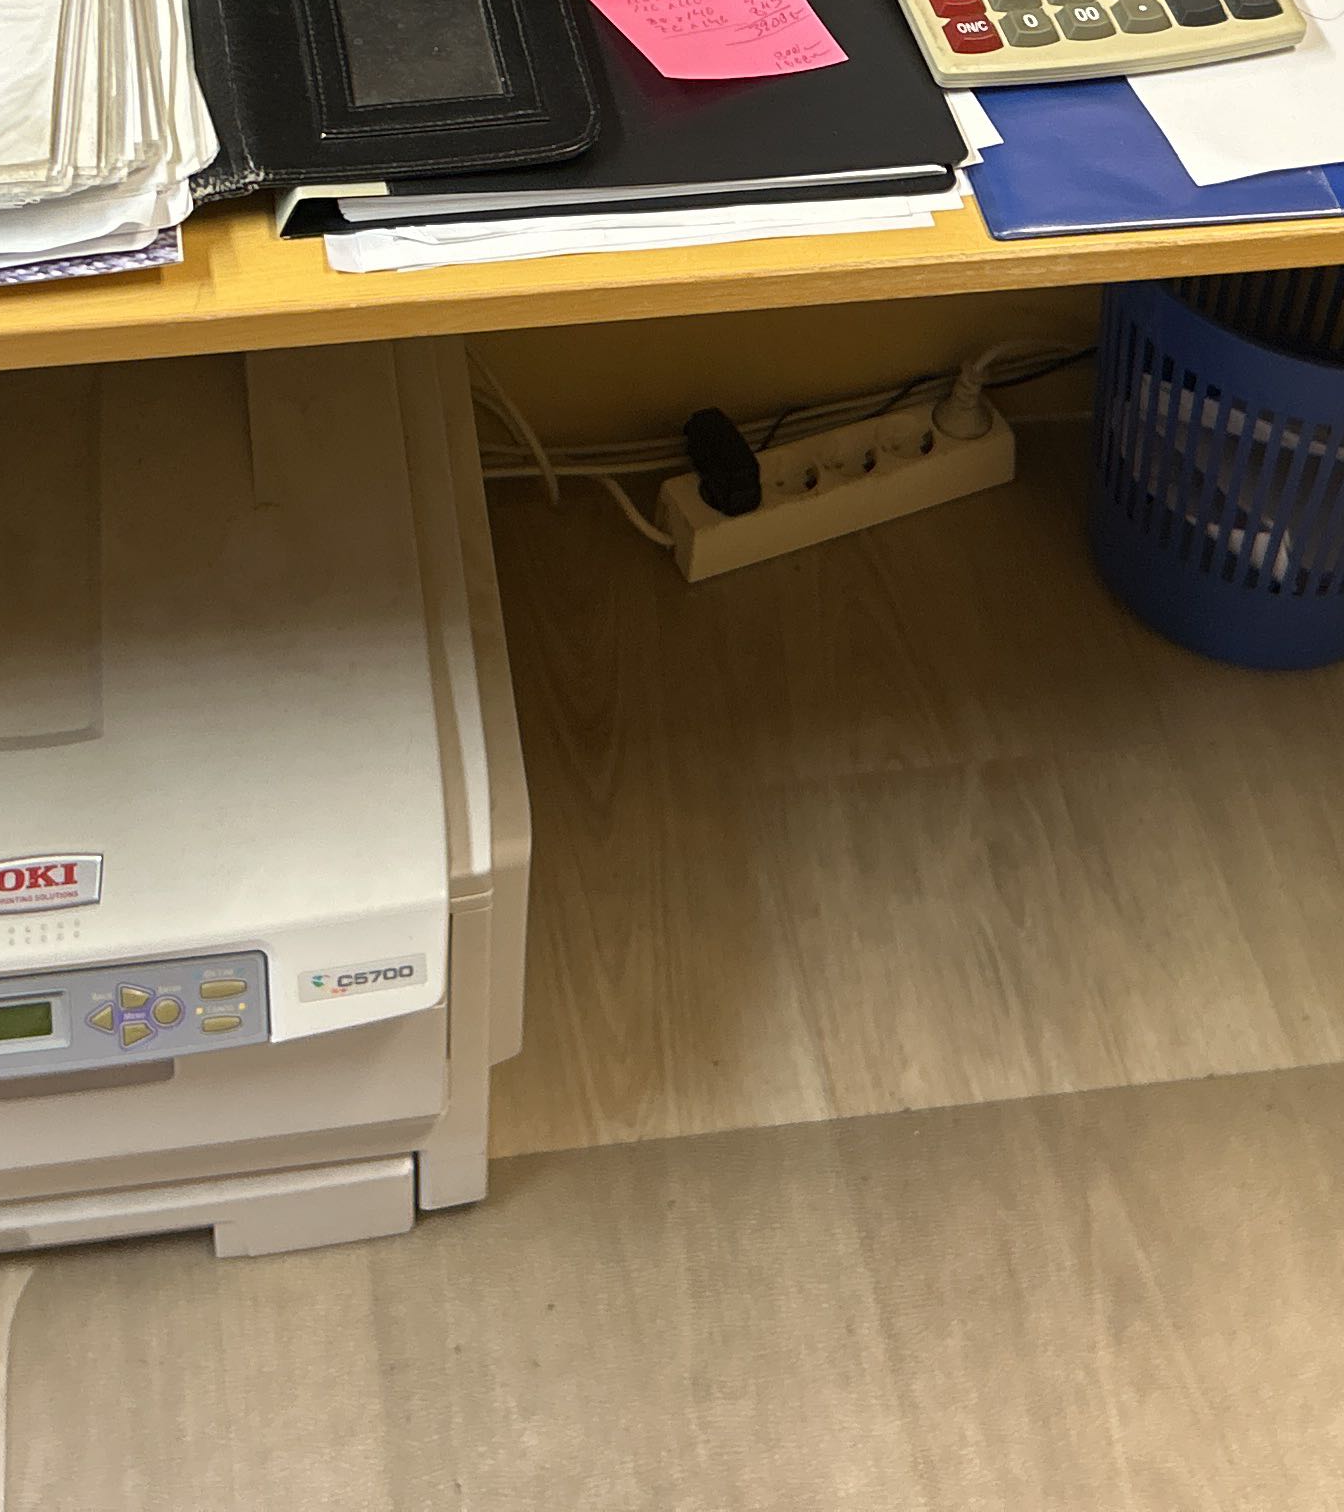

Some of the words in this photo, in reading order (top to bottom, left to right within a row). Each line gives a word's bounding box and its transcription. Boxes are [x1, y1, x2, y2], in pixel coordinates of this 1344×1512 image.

[1022, 14, 1038, 28] 0
[1074, 6, 1099, 22] 00
[337, 965, 413, 987] C5700
